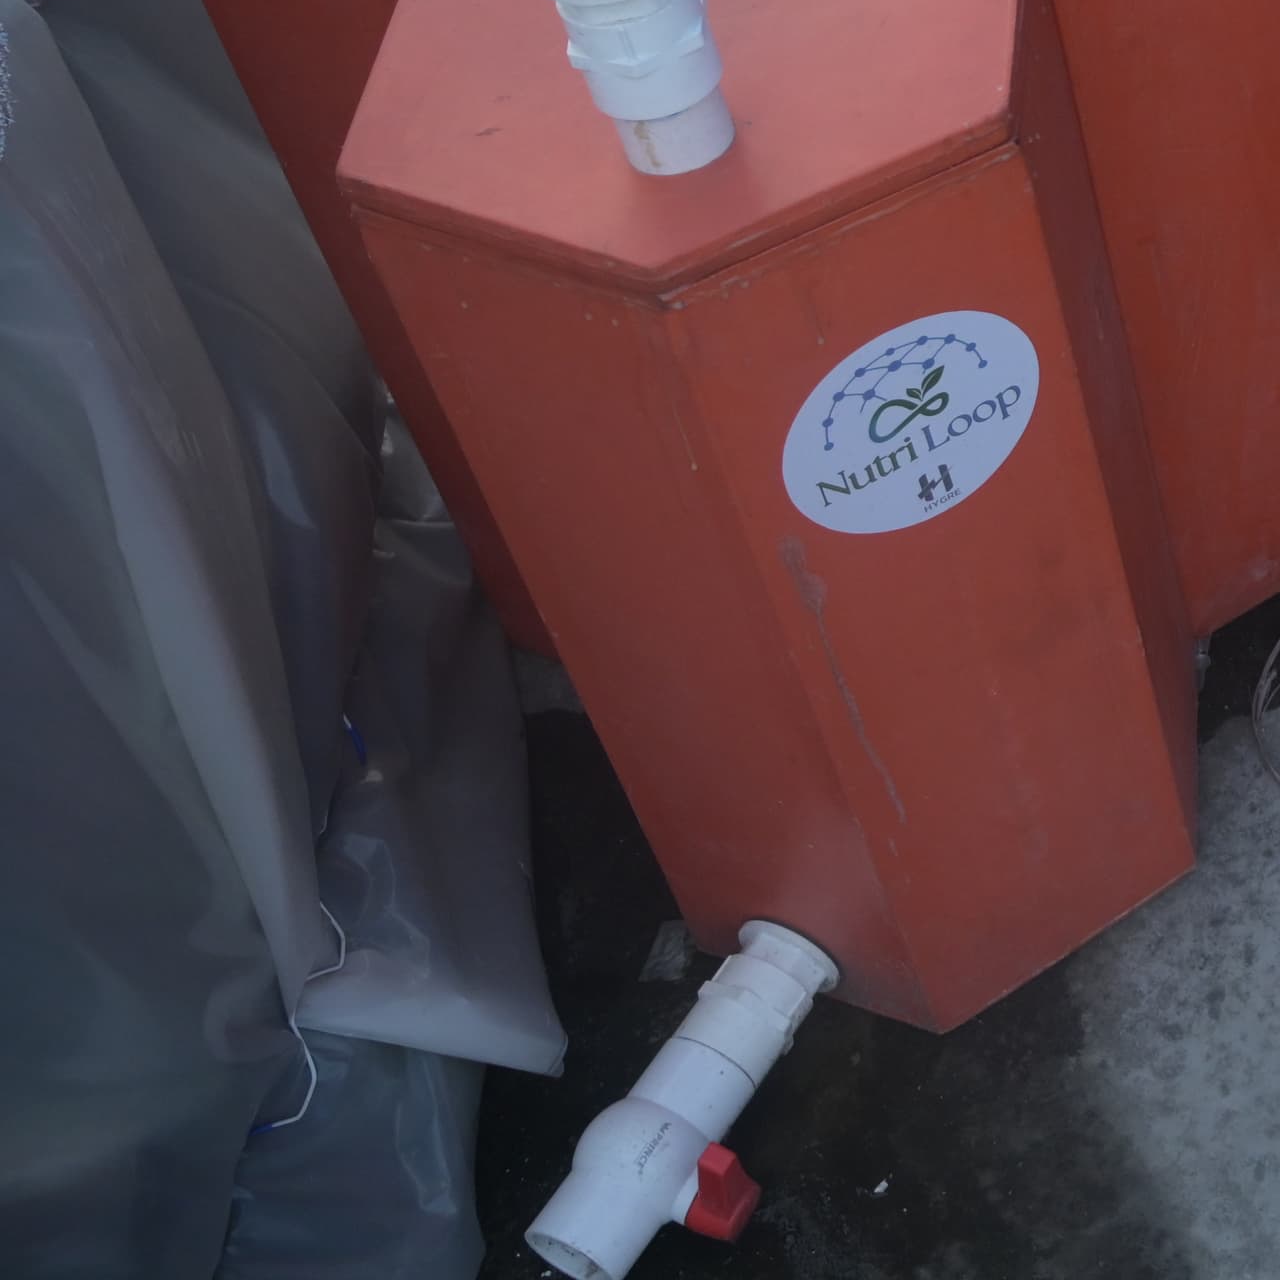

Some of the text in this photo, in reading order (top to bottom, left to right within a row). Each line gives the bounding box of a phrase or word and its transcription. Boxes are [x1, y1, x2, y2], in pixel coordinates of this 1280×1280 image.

[815, 383, 1022, 507] Nutri Loop
[923, 487, 962, 513] HYGRE
